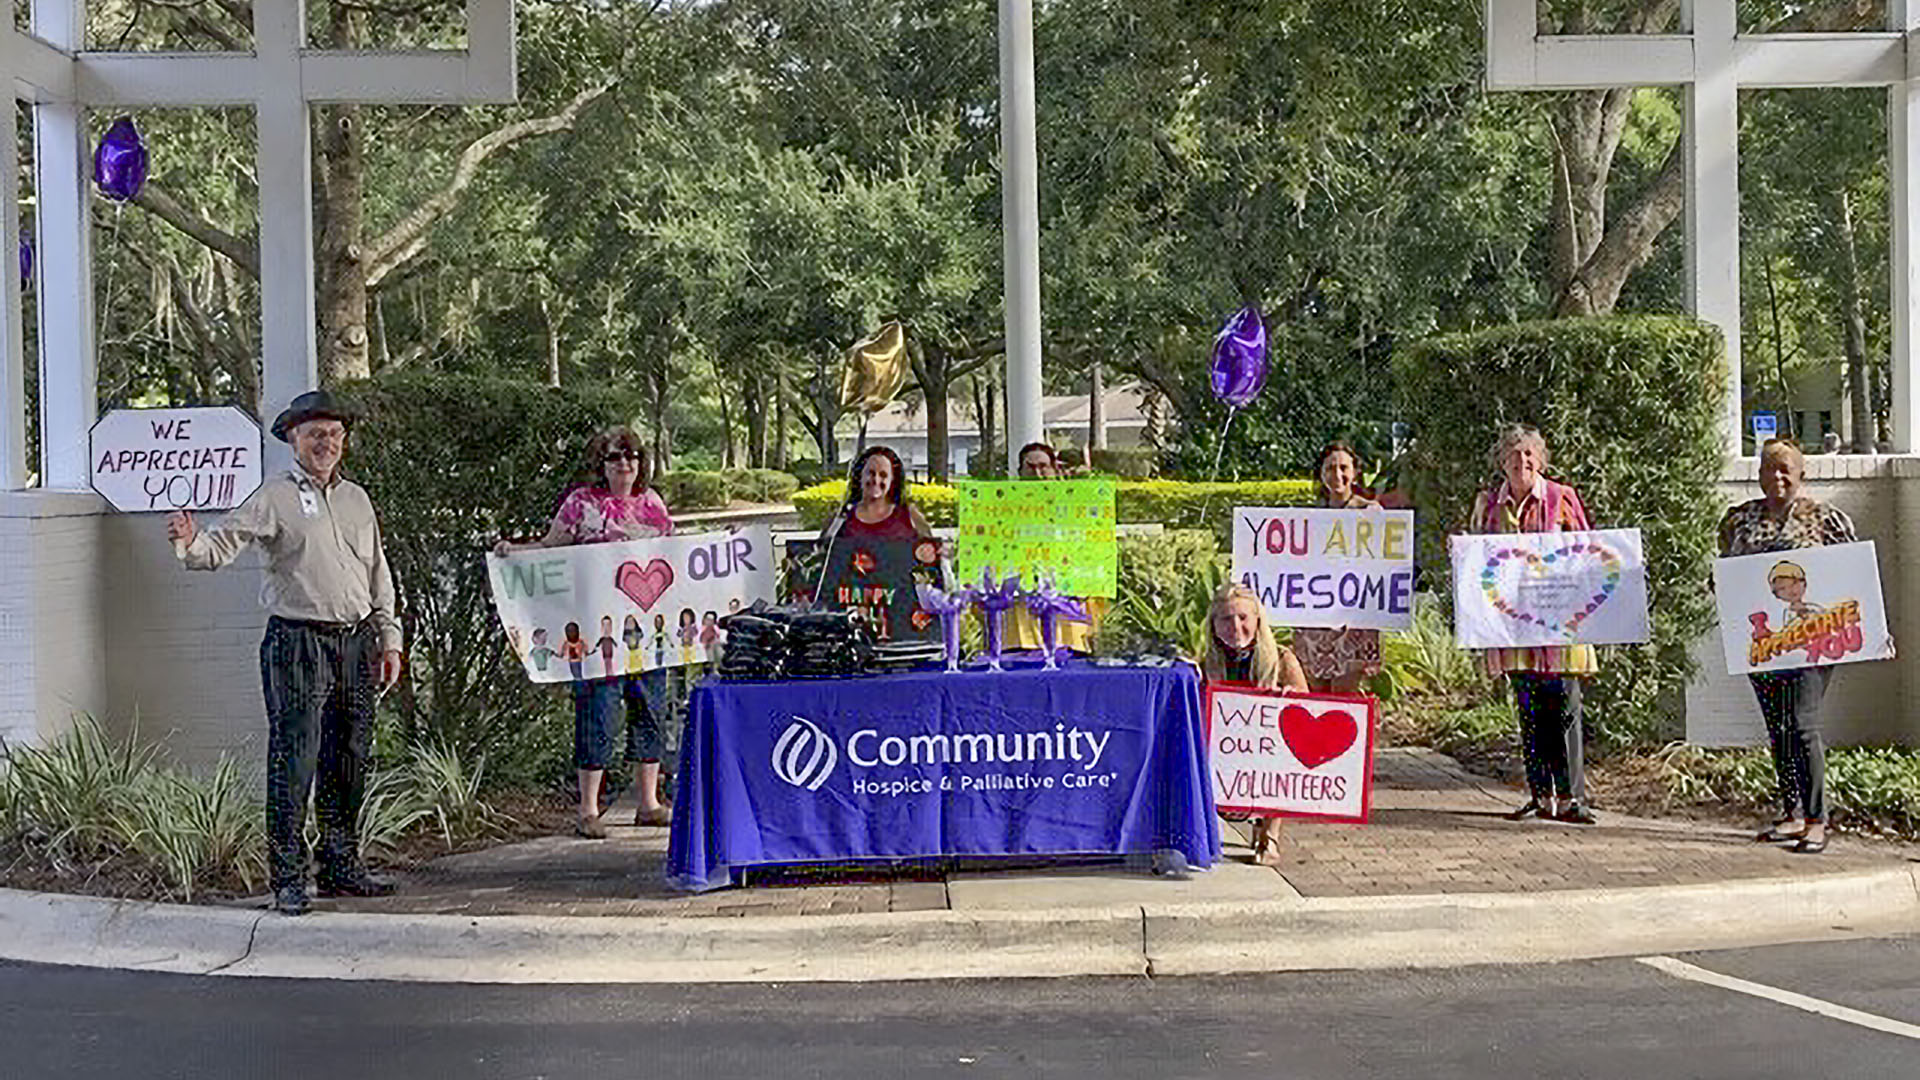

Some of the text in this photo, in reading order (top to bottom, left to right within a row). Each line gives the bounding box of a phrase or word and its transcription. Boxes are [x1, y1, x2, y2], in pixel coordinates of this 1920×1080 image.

[151, 419, 191, 440] WE
[97, 447, 248, 473] APPRECIATE
[1244, 516, 1407, 560] YOU ARE
[501, 538, 757, 599] WE OUR
[839, 587, 896, 605] HAPPY
[1749, 611, 1768, 639] I
[1806, 617, 1863, 663] YOU
[1217, 701, 1278, 728] WE
[848, 722, 1111, 770] Community
[853, 777, 932, 797] Hospice
[939, 776, 953, 791] &
[961, 774, 1054, 791] Palliative
[1216, 768, 1347, 801] VOLUNTEERS
